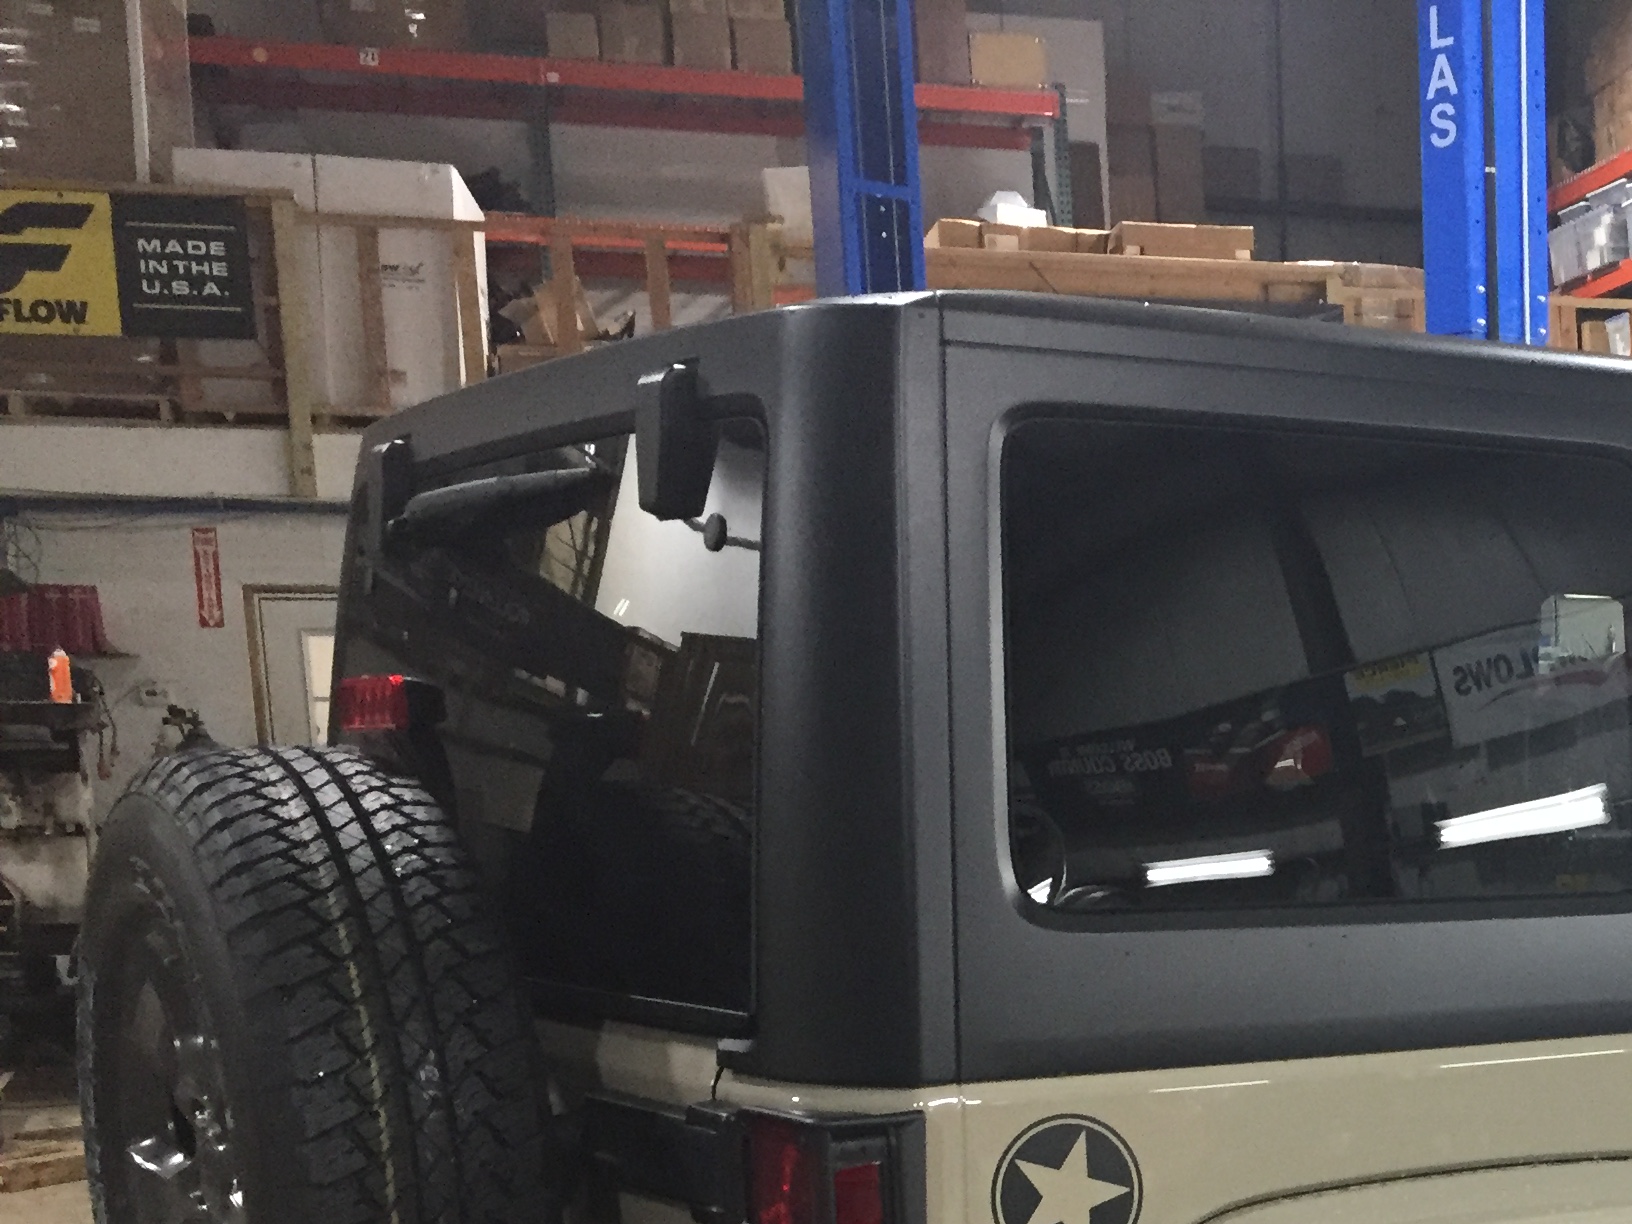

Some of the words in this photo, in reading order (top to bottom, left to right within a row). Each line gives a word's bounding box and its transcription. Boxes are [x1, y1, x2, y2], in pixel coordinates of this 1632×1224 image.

[1426, 6, 1458, 149] LAS
[137, 238, 226, 256] MADE
[140, 259, 168, 274] IN
[172, 260, 228, 276] THE
[141, 279, 230, 296] U.S.A.
